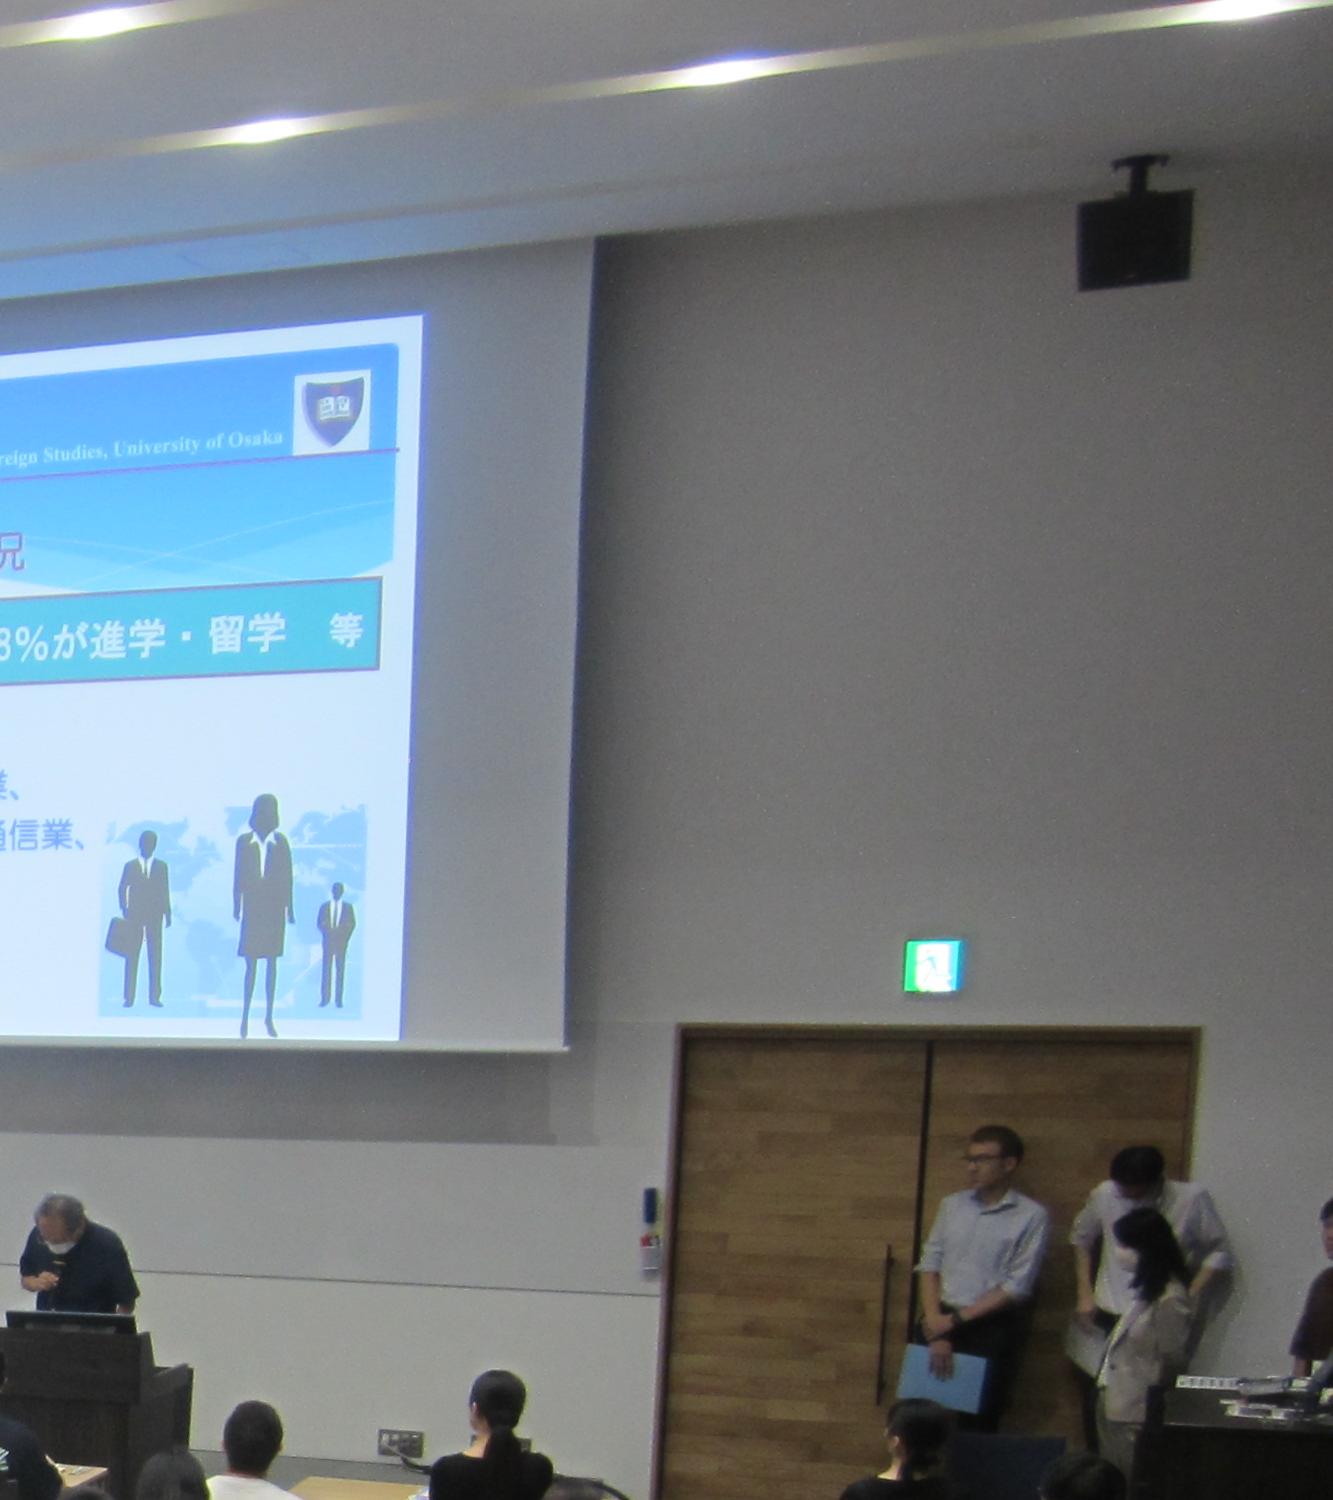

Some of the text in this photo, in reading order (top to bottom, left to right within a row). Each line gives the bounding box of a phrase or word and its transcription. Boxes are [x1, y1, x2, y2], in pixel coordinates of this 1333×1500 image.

[43, 445, 108, 464] Studies,
[113, 437, 200, 458] University
[206, 433, 223, 449] of
[228, 429, 284, 448] Osaka
[329, 612, 365, 649] 等
